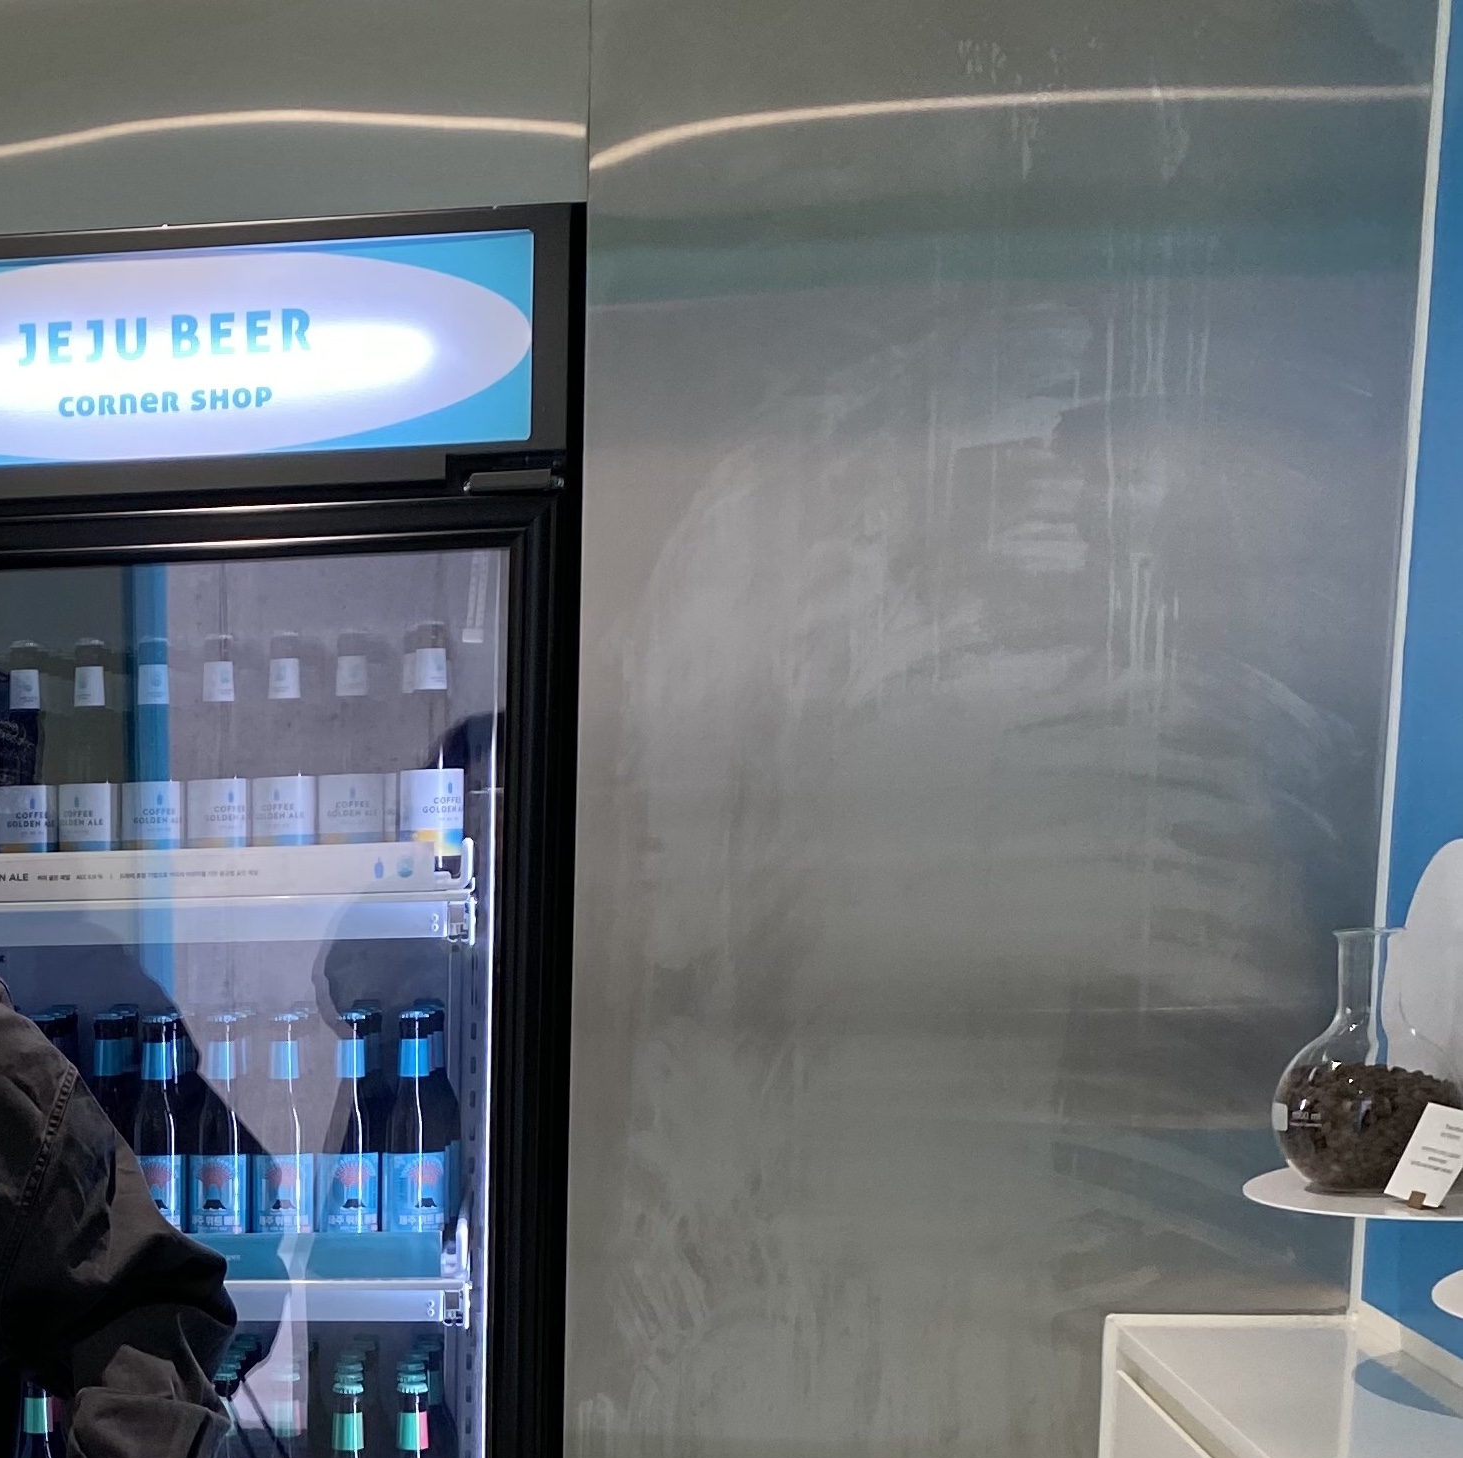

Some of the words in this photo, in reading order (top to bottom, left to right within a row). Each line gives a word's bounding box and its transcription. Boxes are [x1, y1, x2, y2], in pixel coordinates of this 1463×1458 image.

[19, 317, 147, 366] JEJU
[171, 308, 311, 359] BEER
[191, 386, 273, 411] SHOP
[9, 873, 29, 882] ALE
